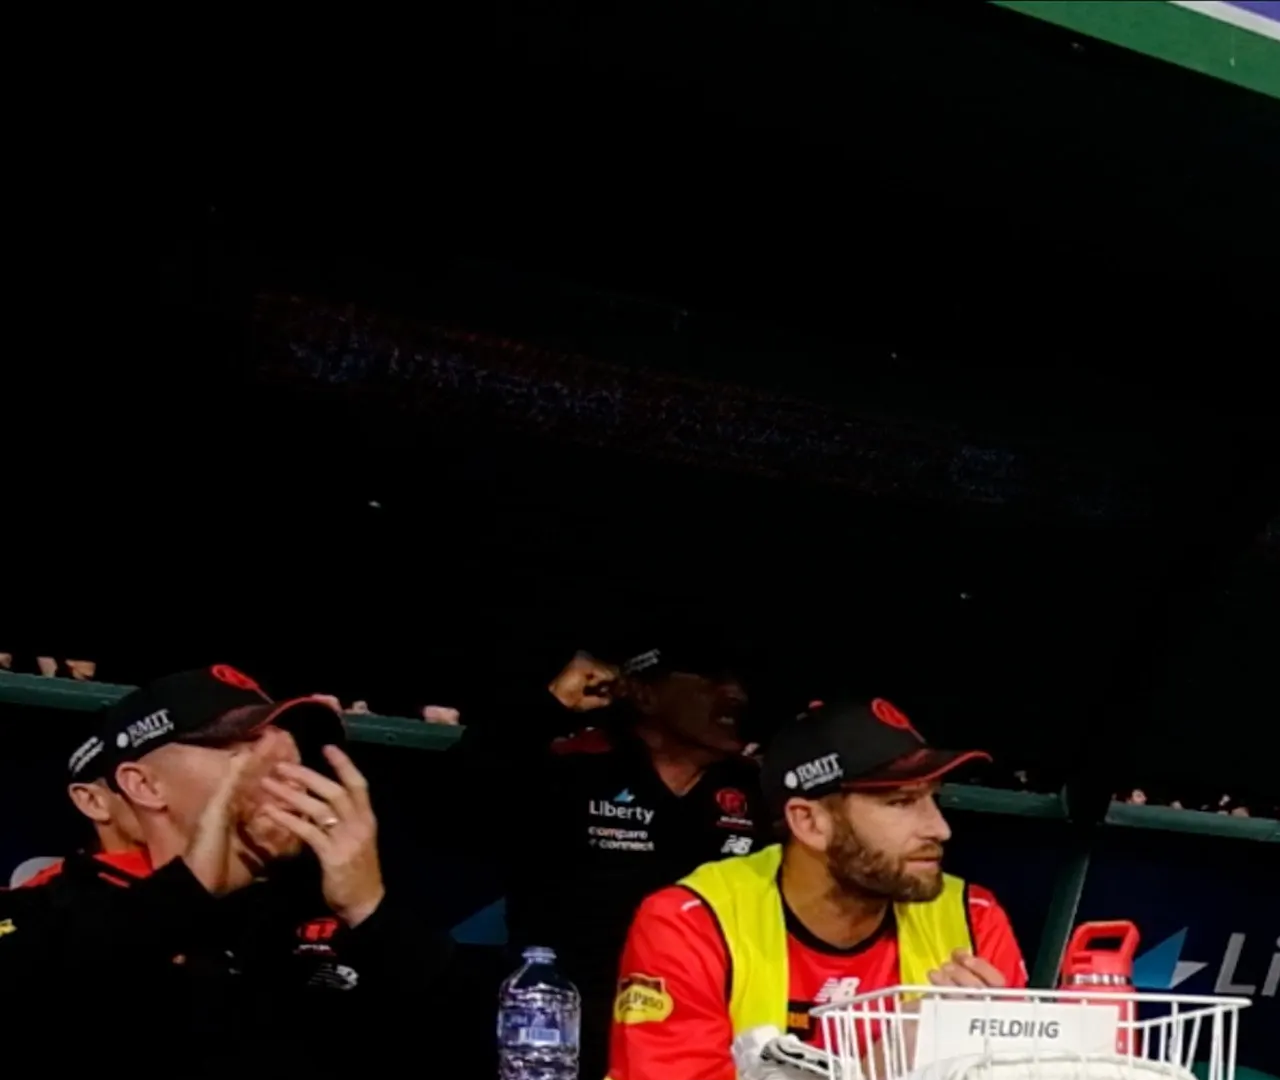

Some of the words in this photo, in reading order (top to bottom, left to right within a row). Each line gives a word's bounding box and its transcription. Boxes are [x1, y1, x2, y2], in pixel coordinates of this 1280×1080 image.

[127, 708, 170, 739] RMIT
[796, 752, 840, 783] RMIT
[589, 799, 654, 825] Liberty
[969, 1018, 1060, 1039] FIELDING
